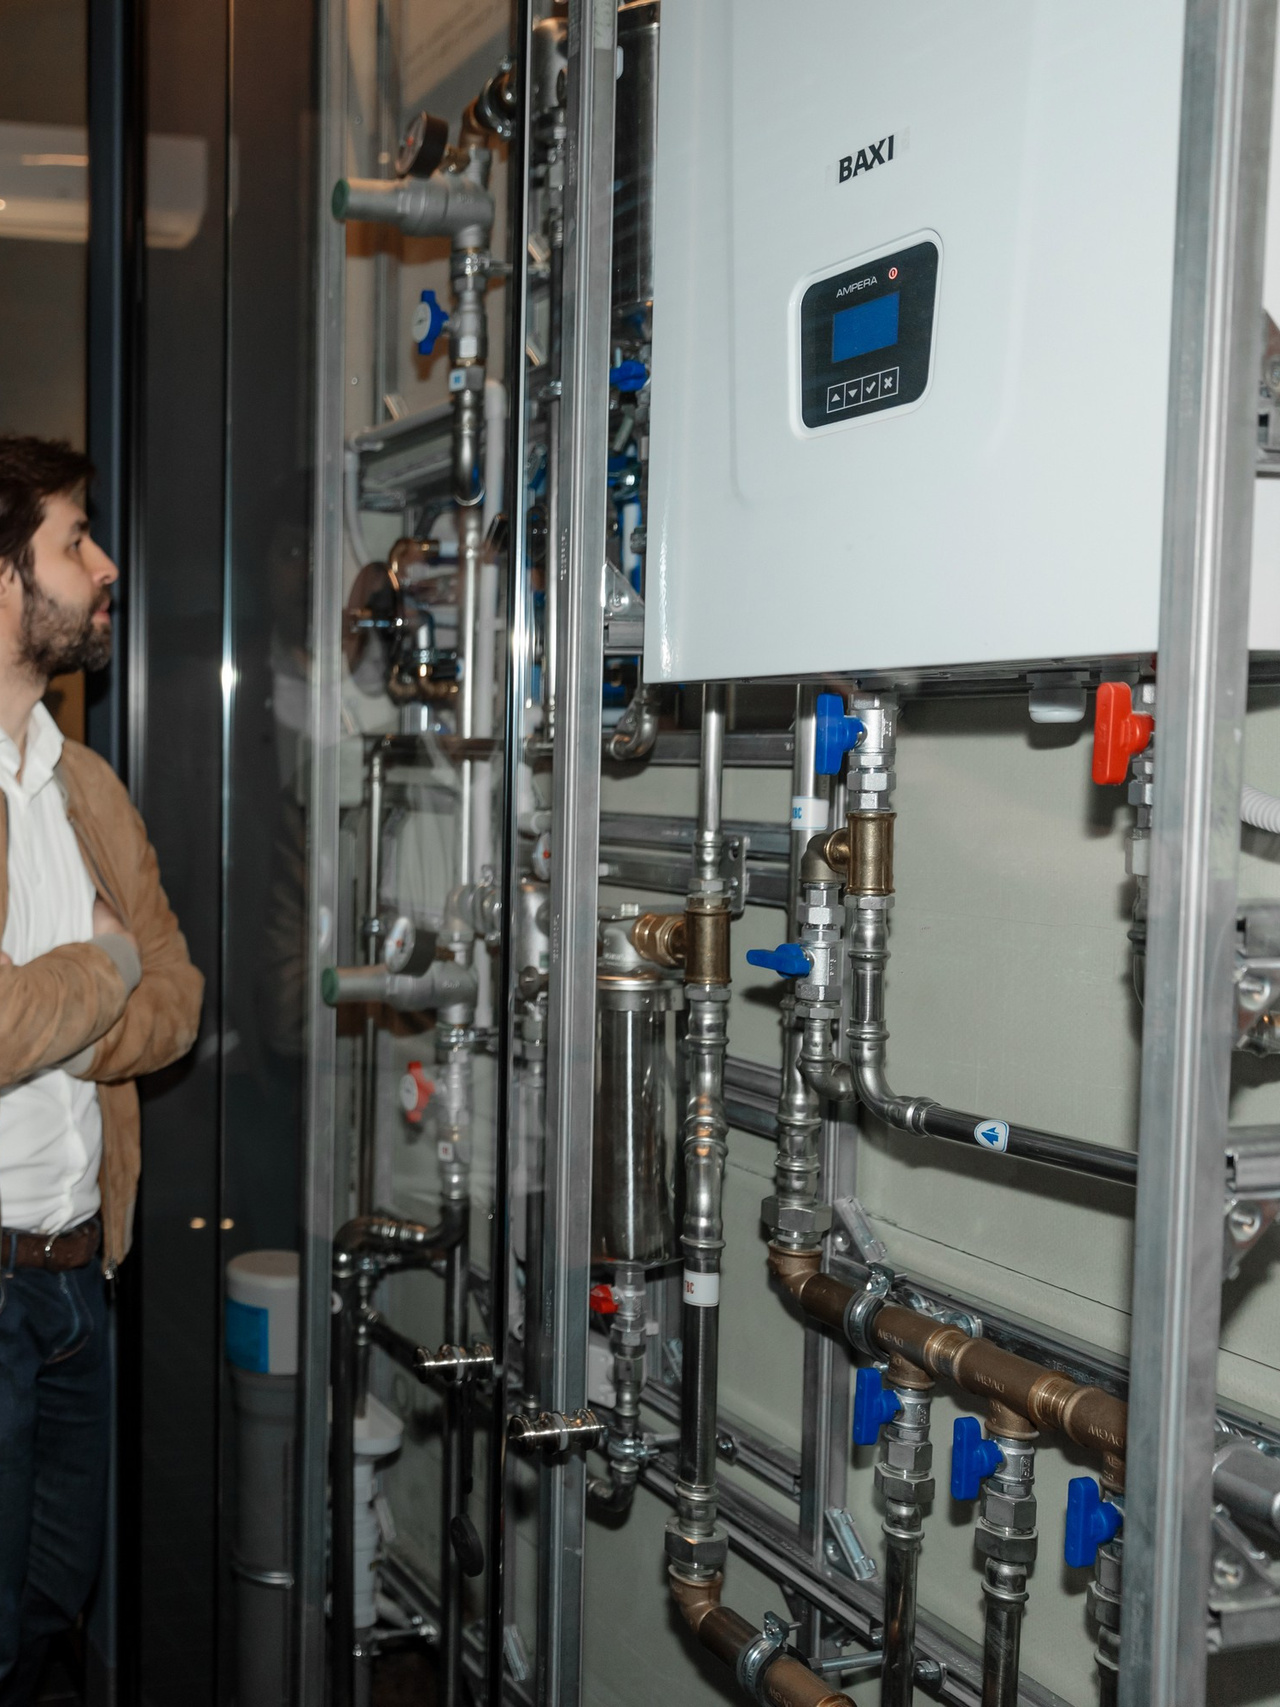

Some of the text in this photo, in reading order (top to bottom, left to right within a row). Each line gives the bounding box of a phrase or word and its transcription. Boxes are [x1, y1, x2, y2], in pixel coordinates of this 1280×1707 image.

[839, 134, 894, 183] BAXI
[836, 276, 878, 298] AMPERA
[1087, 1423, 1124, 1447] DVGW
